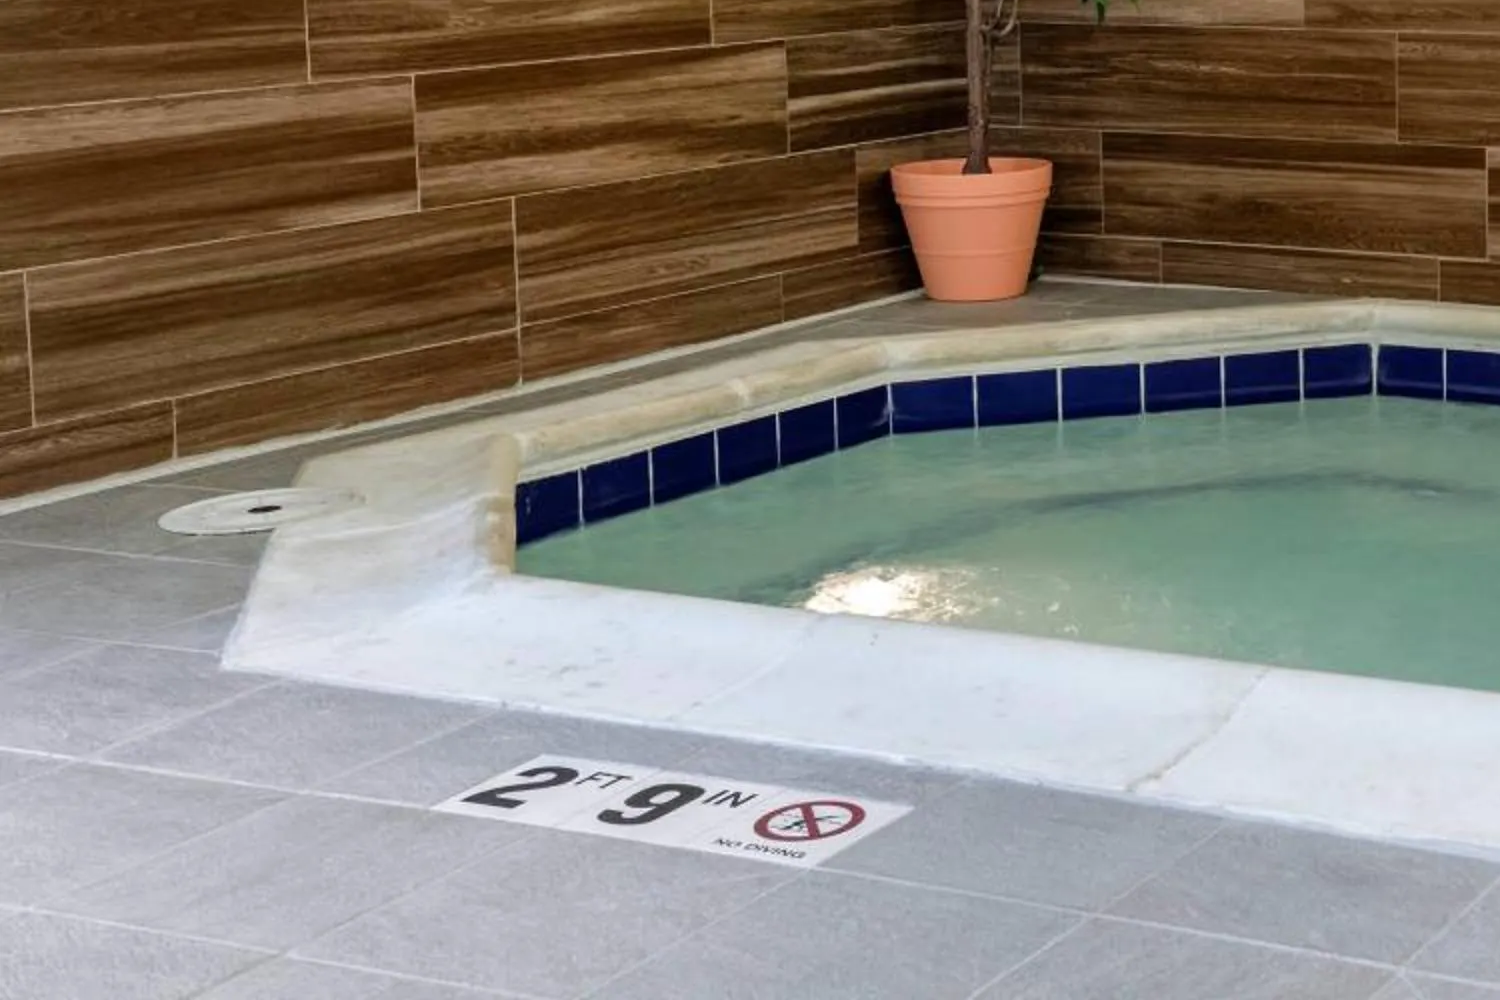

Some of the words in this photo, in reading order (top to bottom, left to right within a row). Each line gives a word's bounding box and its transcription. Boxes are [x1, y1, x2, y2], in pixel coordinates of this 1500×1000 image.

[461, 766, 579, 809] 2
[575, 771, 633, 789] FT
[597, 783, 706, 825] 9
[702, 789, 759, 809] IN
[713, 838, 742, 848] NO
[743, 842, 807, 859] DIVING
